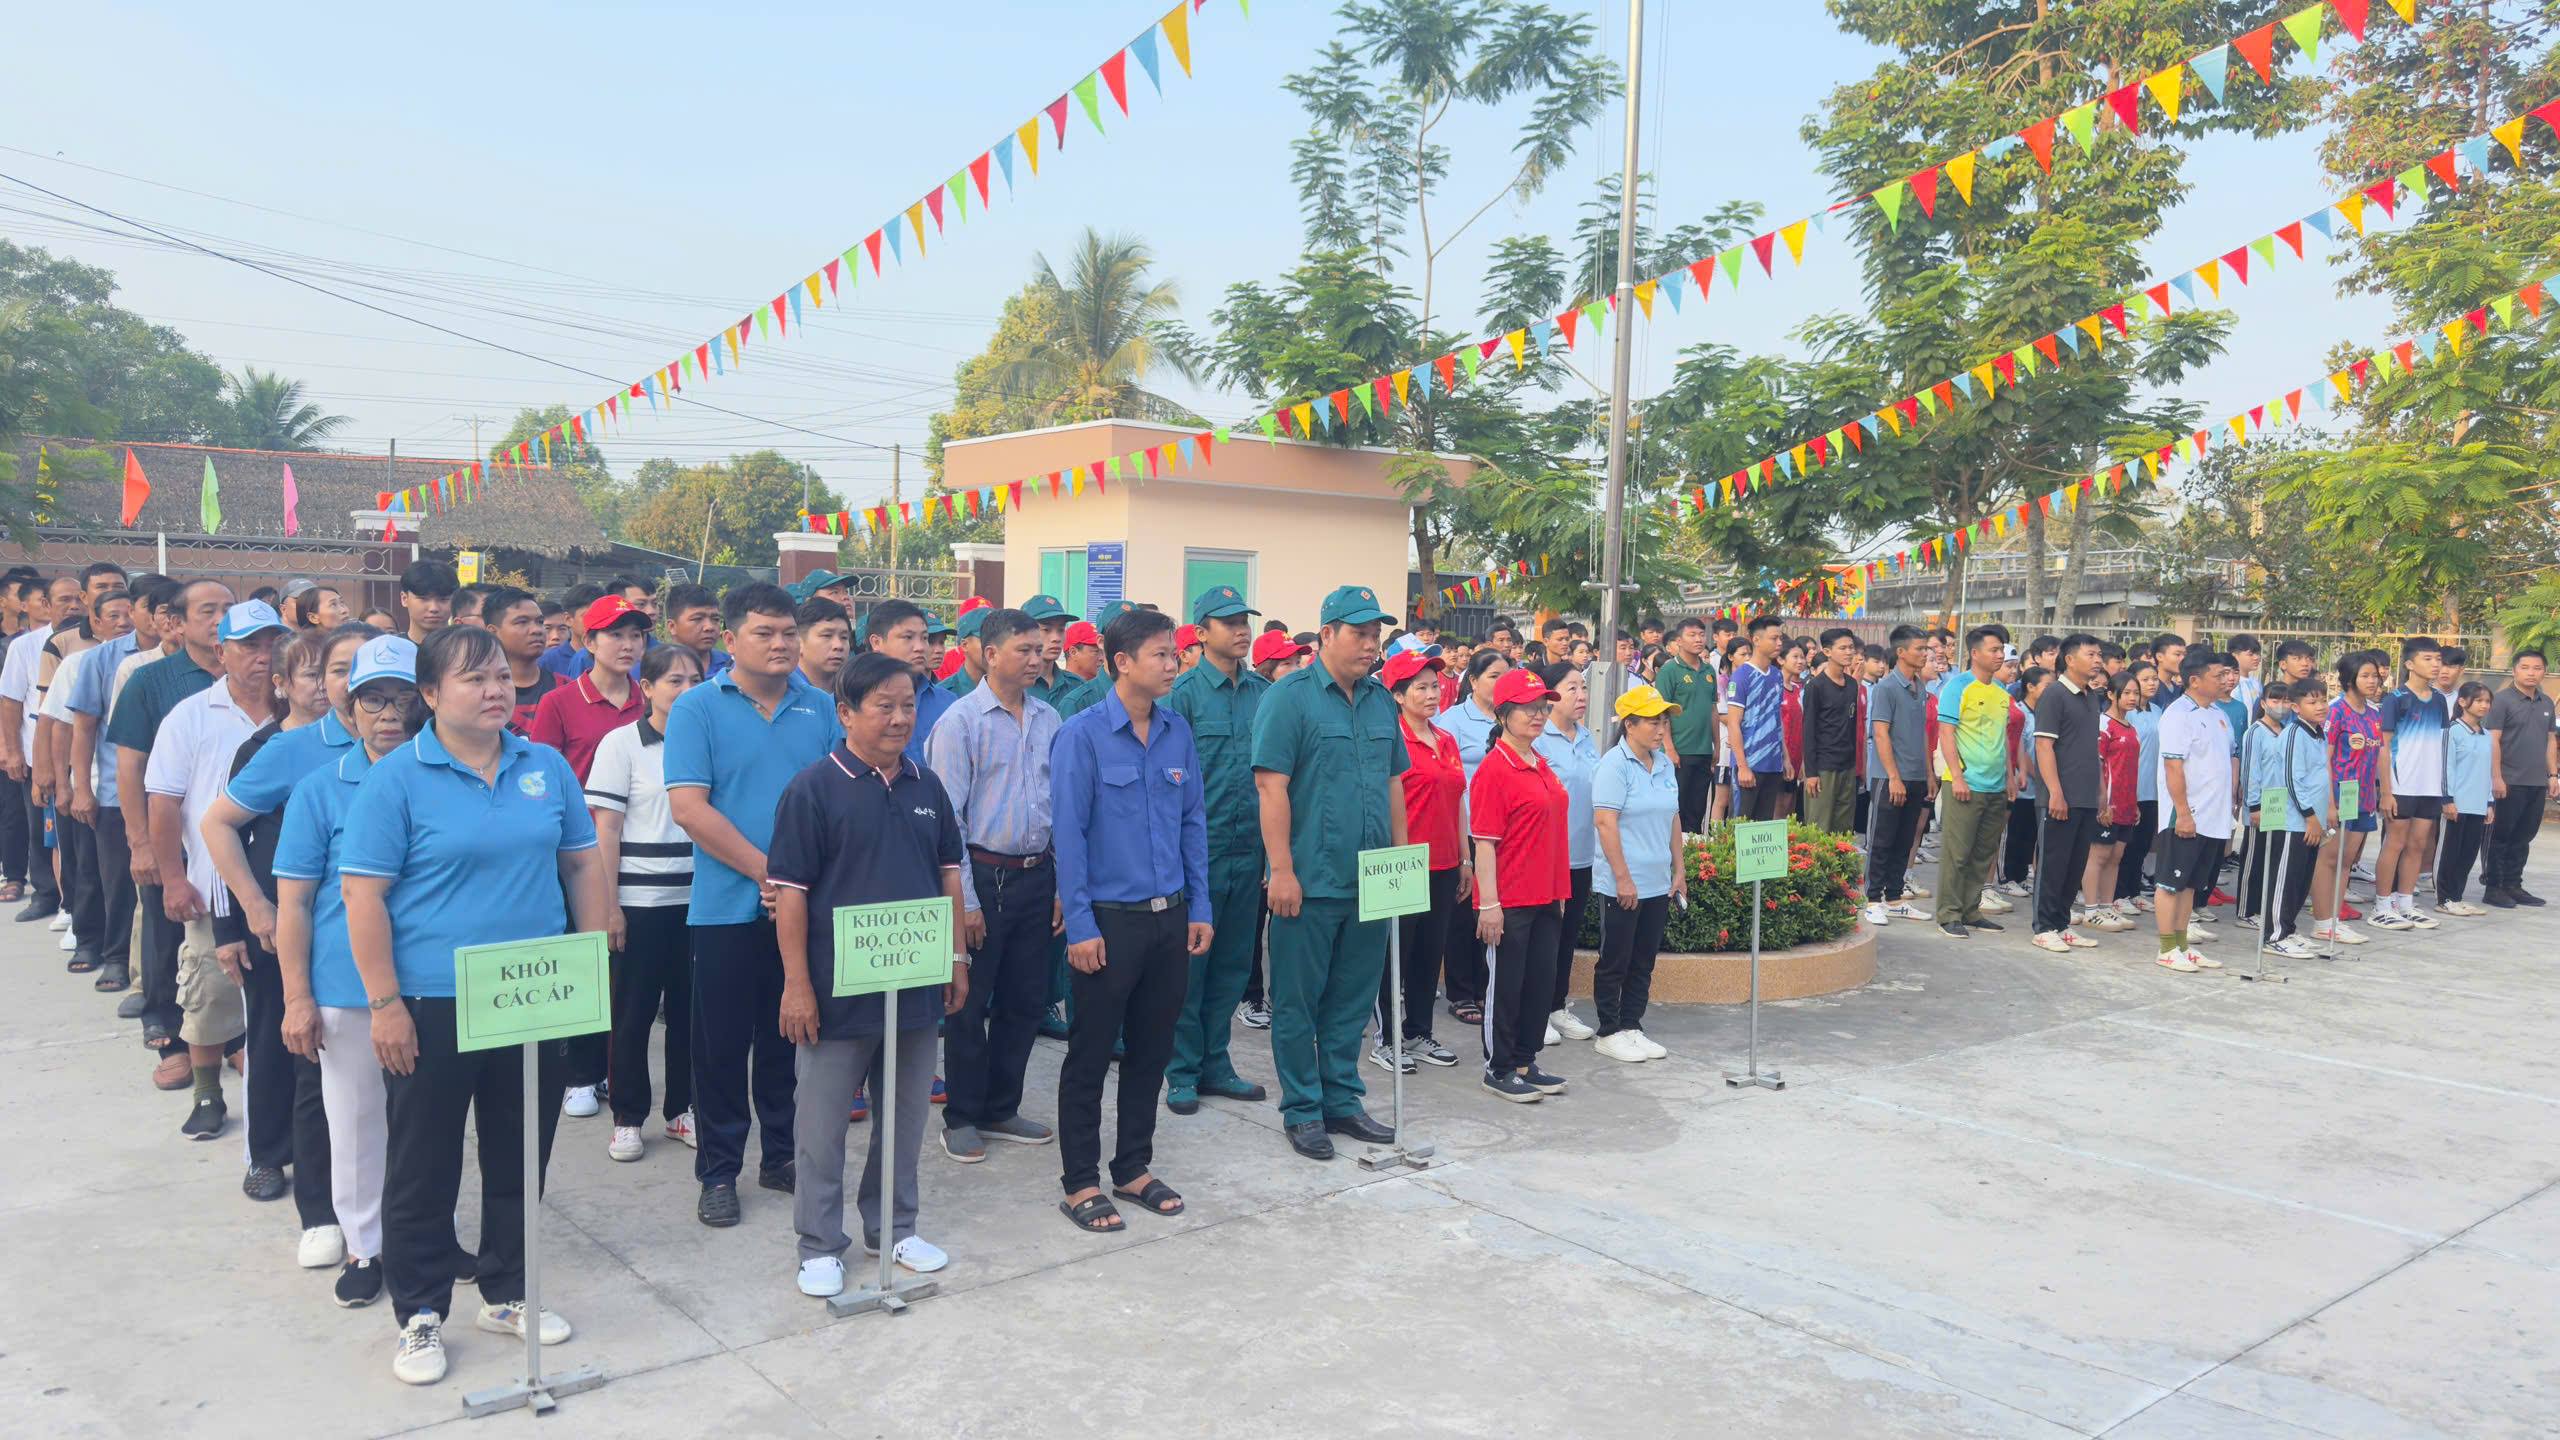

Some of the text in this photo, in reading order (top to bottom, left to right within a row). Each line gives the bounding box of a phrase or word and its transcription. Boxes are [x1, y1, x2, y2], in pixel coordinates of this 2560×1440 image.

[1365, 856, 1425, 877] KHỐI QUÂN
[1388, 876, 1403, 891] SỰ
[852, 906, 940, 929] KHỐI CÁN
[855, 927, 937, 952] BỘ, CÔNG
[500, 956, 558, 981] KHỐI
[870, 948, 921, 969] CHỨC
[493, 982, 575, 1009] CÁC ẤP
